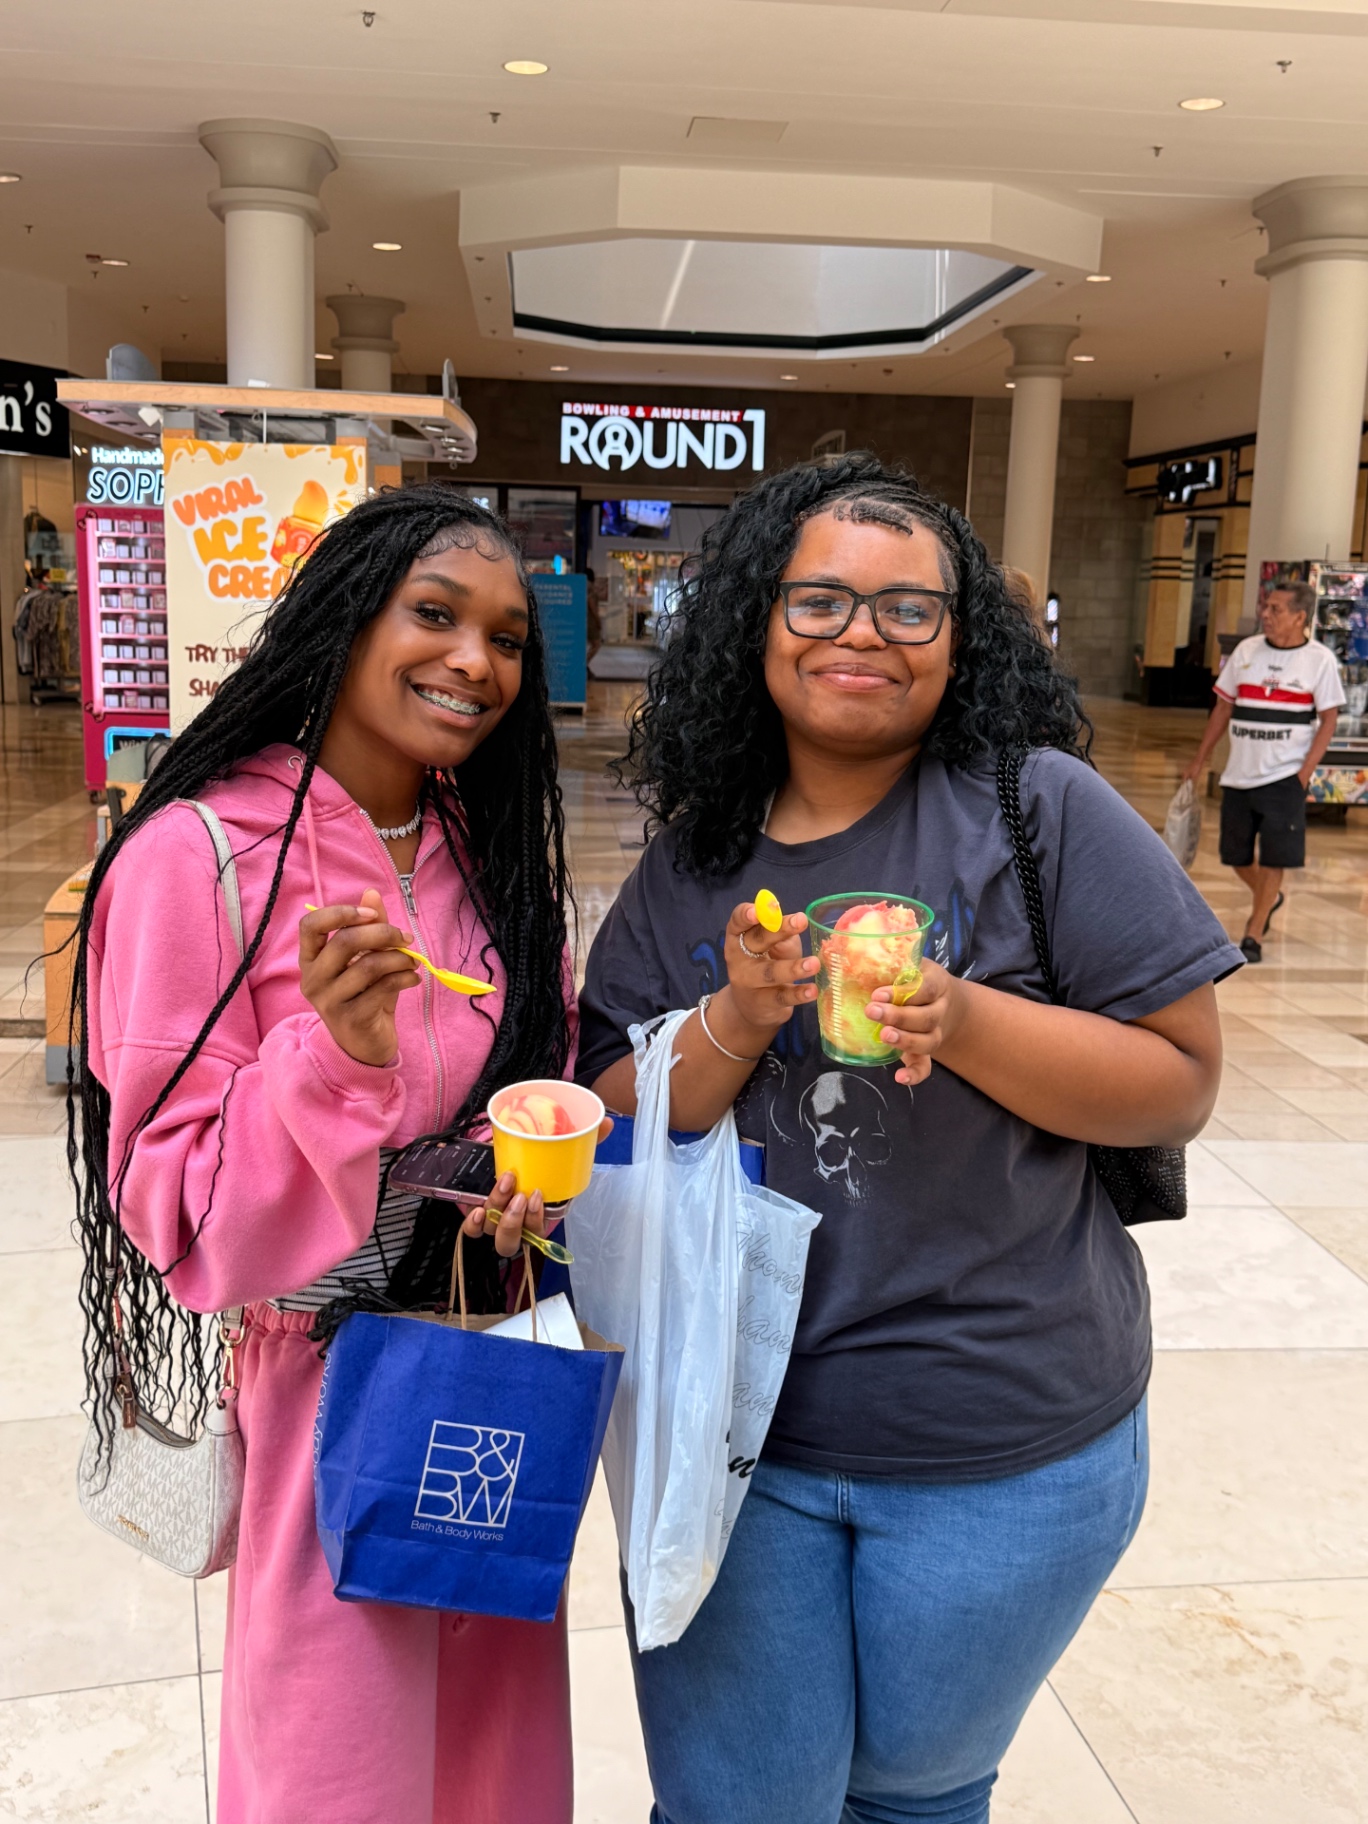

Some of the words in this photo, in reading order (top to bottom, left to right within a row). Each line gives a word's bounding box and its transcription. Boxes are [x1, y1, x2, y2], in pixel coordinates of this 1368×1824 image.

[562, 402, 630, 417] BOWLING
[635, 406, 645, 418] &
[650, 407, 741, 422] AMUSEMENT
[92, 446, 165, 465] Handmad
[172, 477, 263, 526] VIRAL
[193, 516, 268, 566] ICE
[208, 564, 293, 600] CREA
[185, 644, 218, 662] TRY
[410, 1520, 435, 1532] Bath
[435, 1525, 443, 1534] &
[445, 1525, 472, 1539] Body
[473, 1529, 504, 1541] Works
